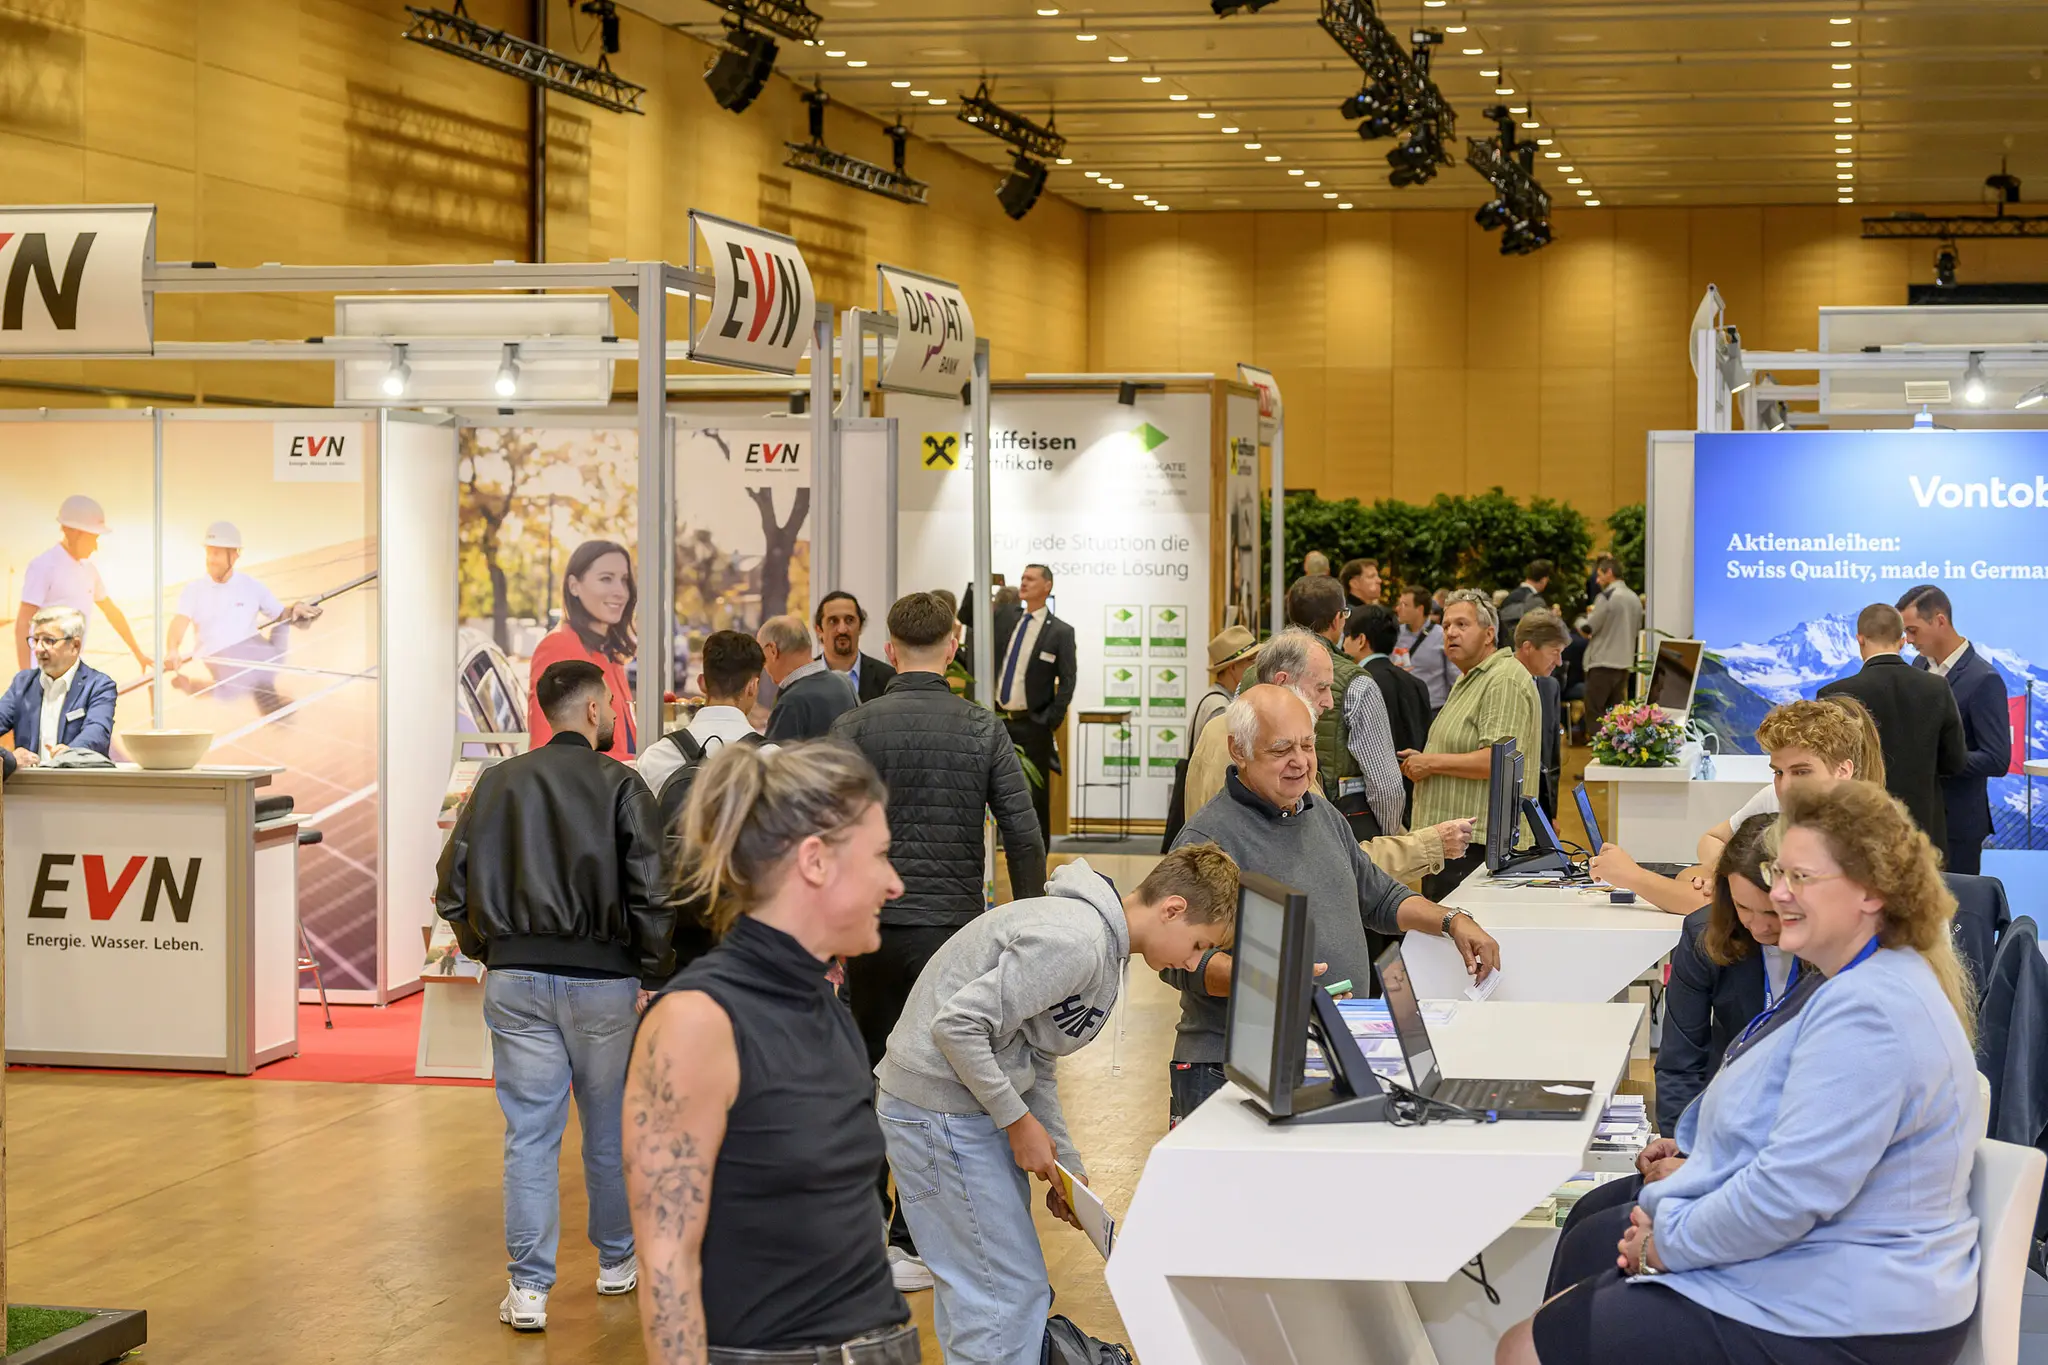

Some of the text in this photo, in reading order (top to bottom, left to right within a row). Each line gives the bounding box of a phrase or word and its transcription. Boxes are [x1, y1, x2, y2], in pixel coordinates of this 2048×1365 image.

[0, 231, 98, 331] N
[719, 241, 801, 348] EVN
[901, 285, 963, 373] DADAT
[290, 436, 345, 457] EVN
[964, 431, 1077, 450] Riffeisen
[745, 443, 800, 464] EVN
[964, 453, 1054, 471] Ztifikate
[993, 533, 1190, 554] Für jede Situation die
[1726, 532, 1901, 551] Aktienanleihen:
[1046, 561, 1189, 581] ssende Lösung
[1726, 559, 2048, 583] Swiss Quality, made in Germa
[27, 853, 202, 923] EVN
[26, 933, 204, 951] Energie. Wasser. Leben.
